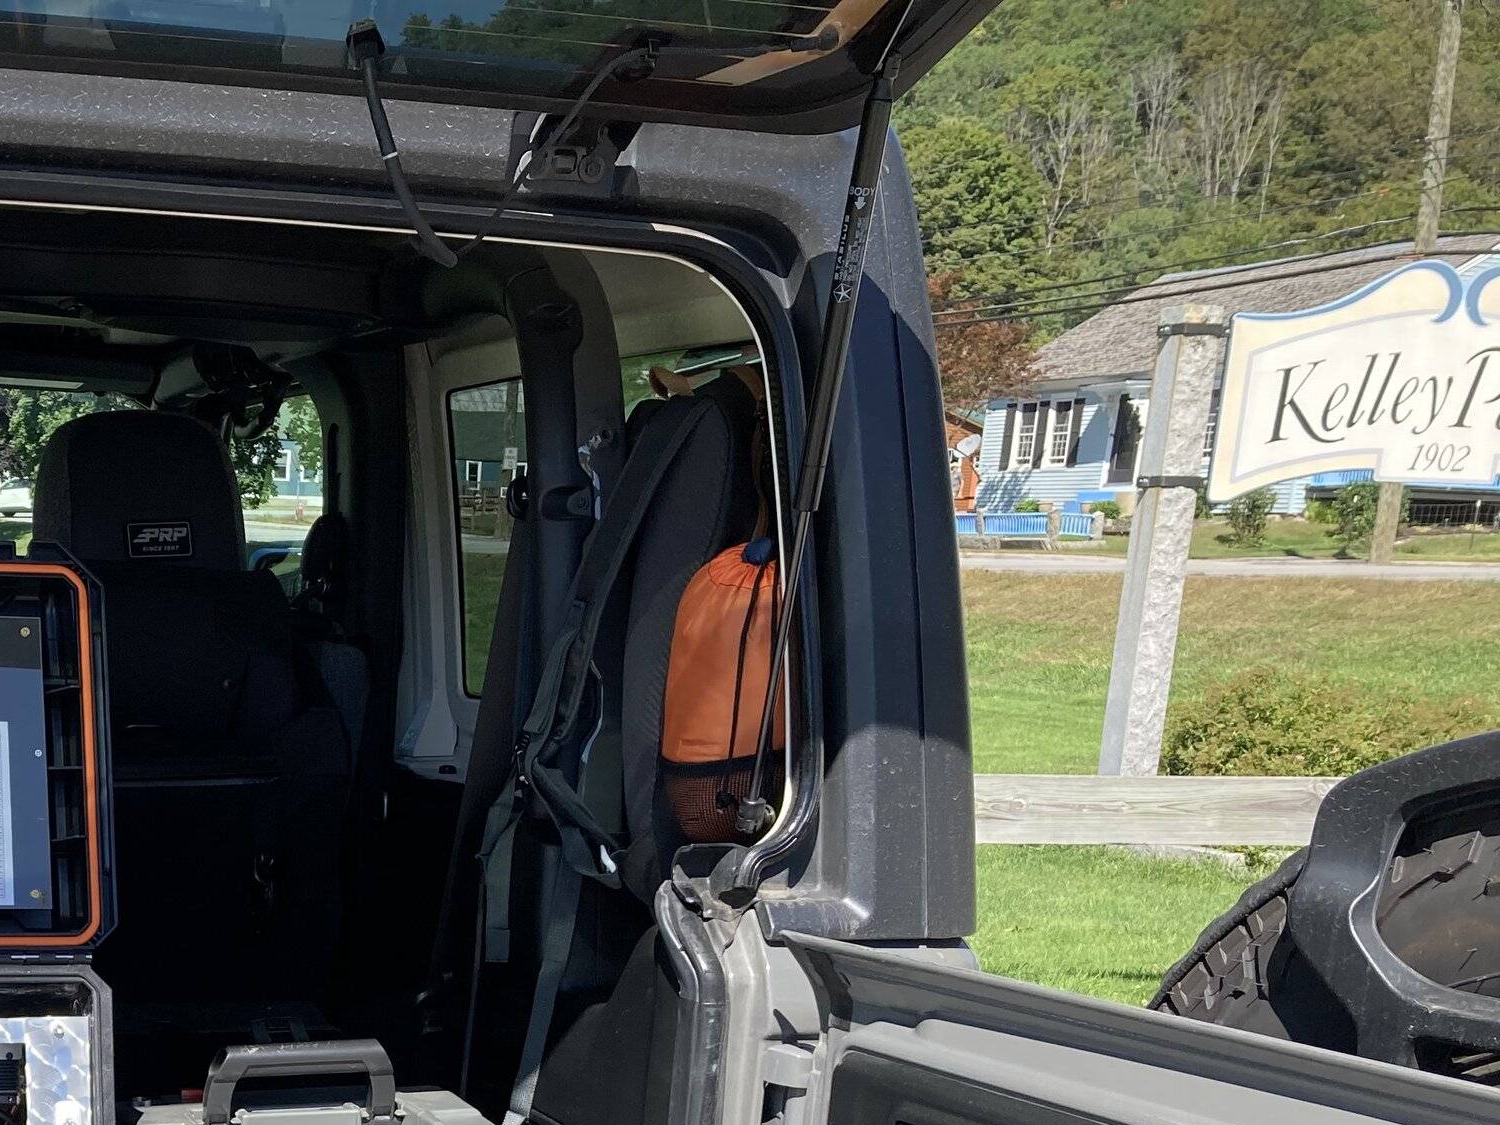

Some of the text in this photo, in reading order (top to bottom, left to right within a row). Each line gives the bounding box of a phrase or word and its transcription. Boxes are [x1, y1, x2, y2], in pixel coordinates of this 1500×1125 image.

[849, 187, 876, 197] BODY
[1264, 346, 1500, 444] Kelley P
[1407, 442, 1472, 473] 1902
[132, 527, 187, 543] PRP
